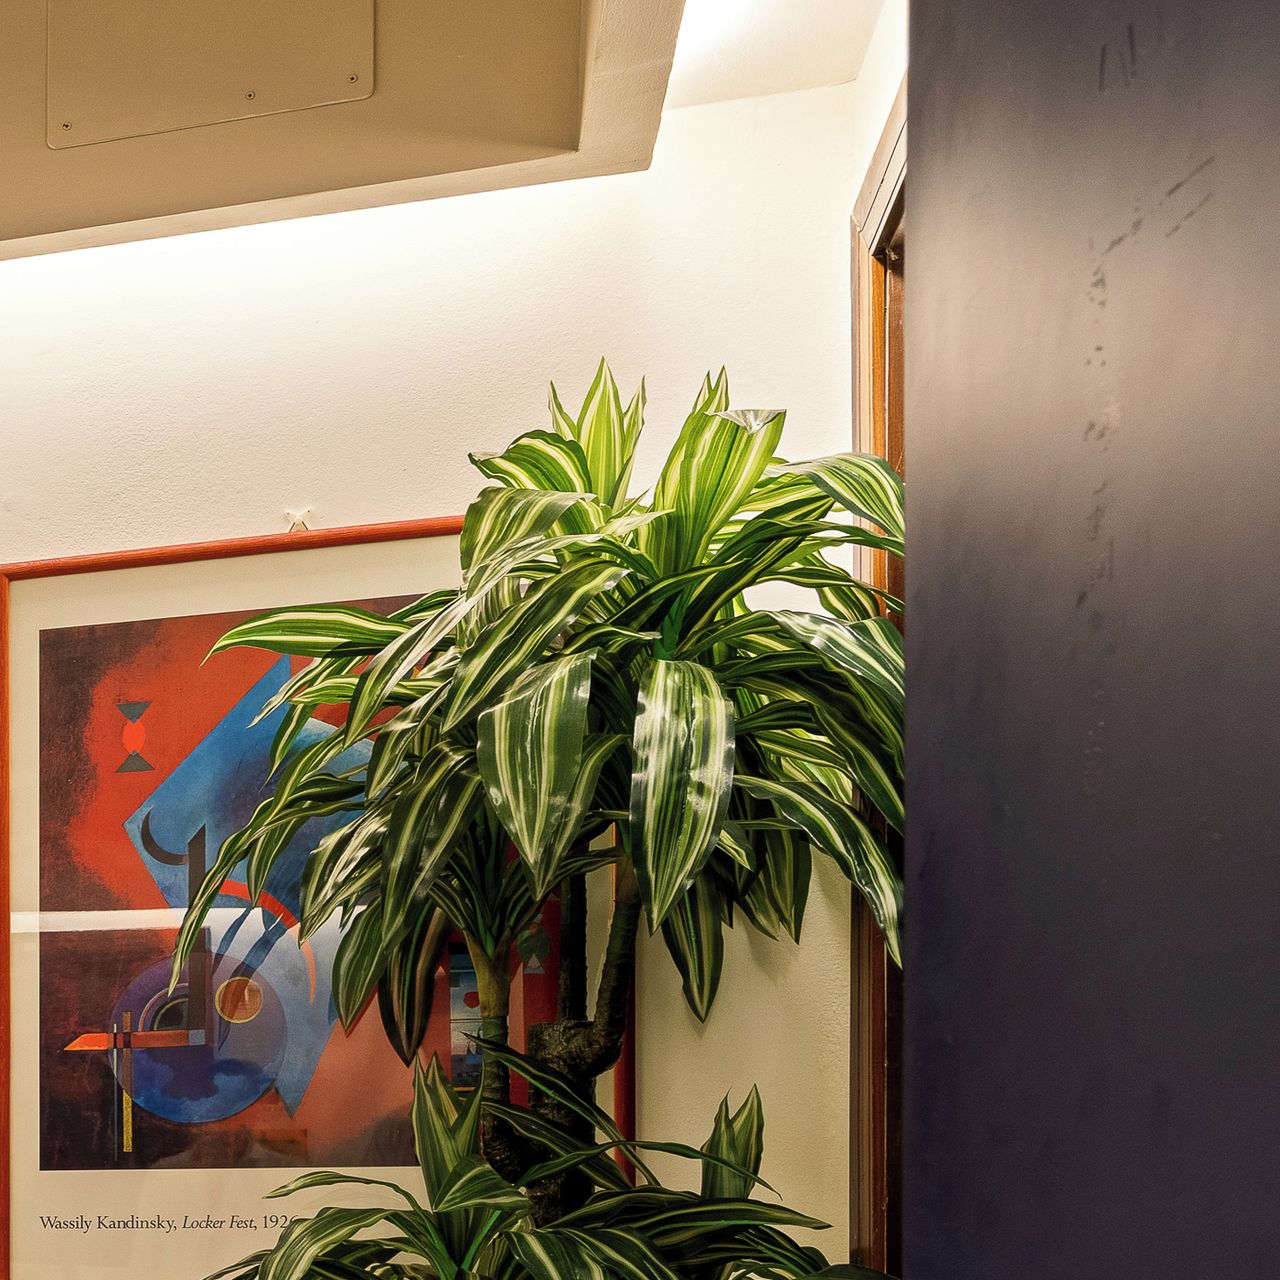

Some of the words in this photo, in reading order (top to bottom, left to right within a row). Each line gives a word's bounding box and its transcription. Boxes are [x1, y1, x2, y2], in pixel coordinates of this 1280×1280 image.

[39, 1214, 92, 1233] Wassily
[96, 1214, 177, 1233] Kandinsky,
[182, 1214, 226, 1229] Locker
[229, 1214, 257, 1231] Fest,
